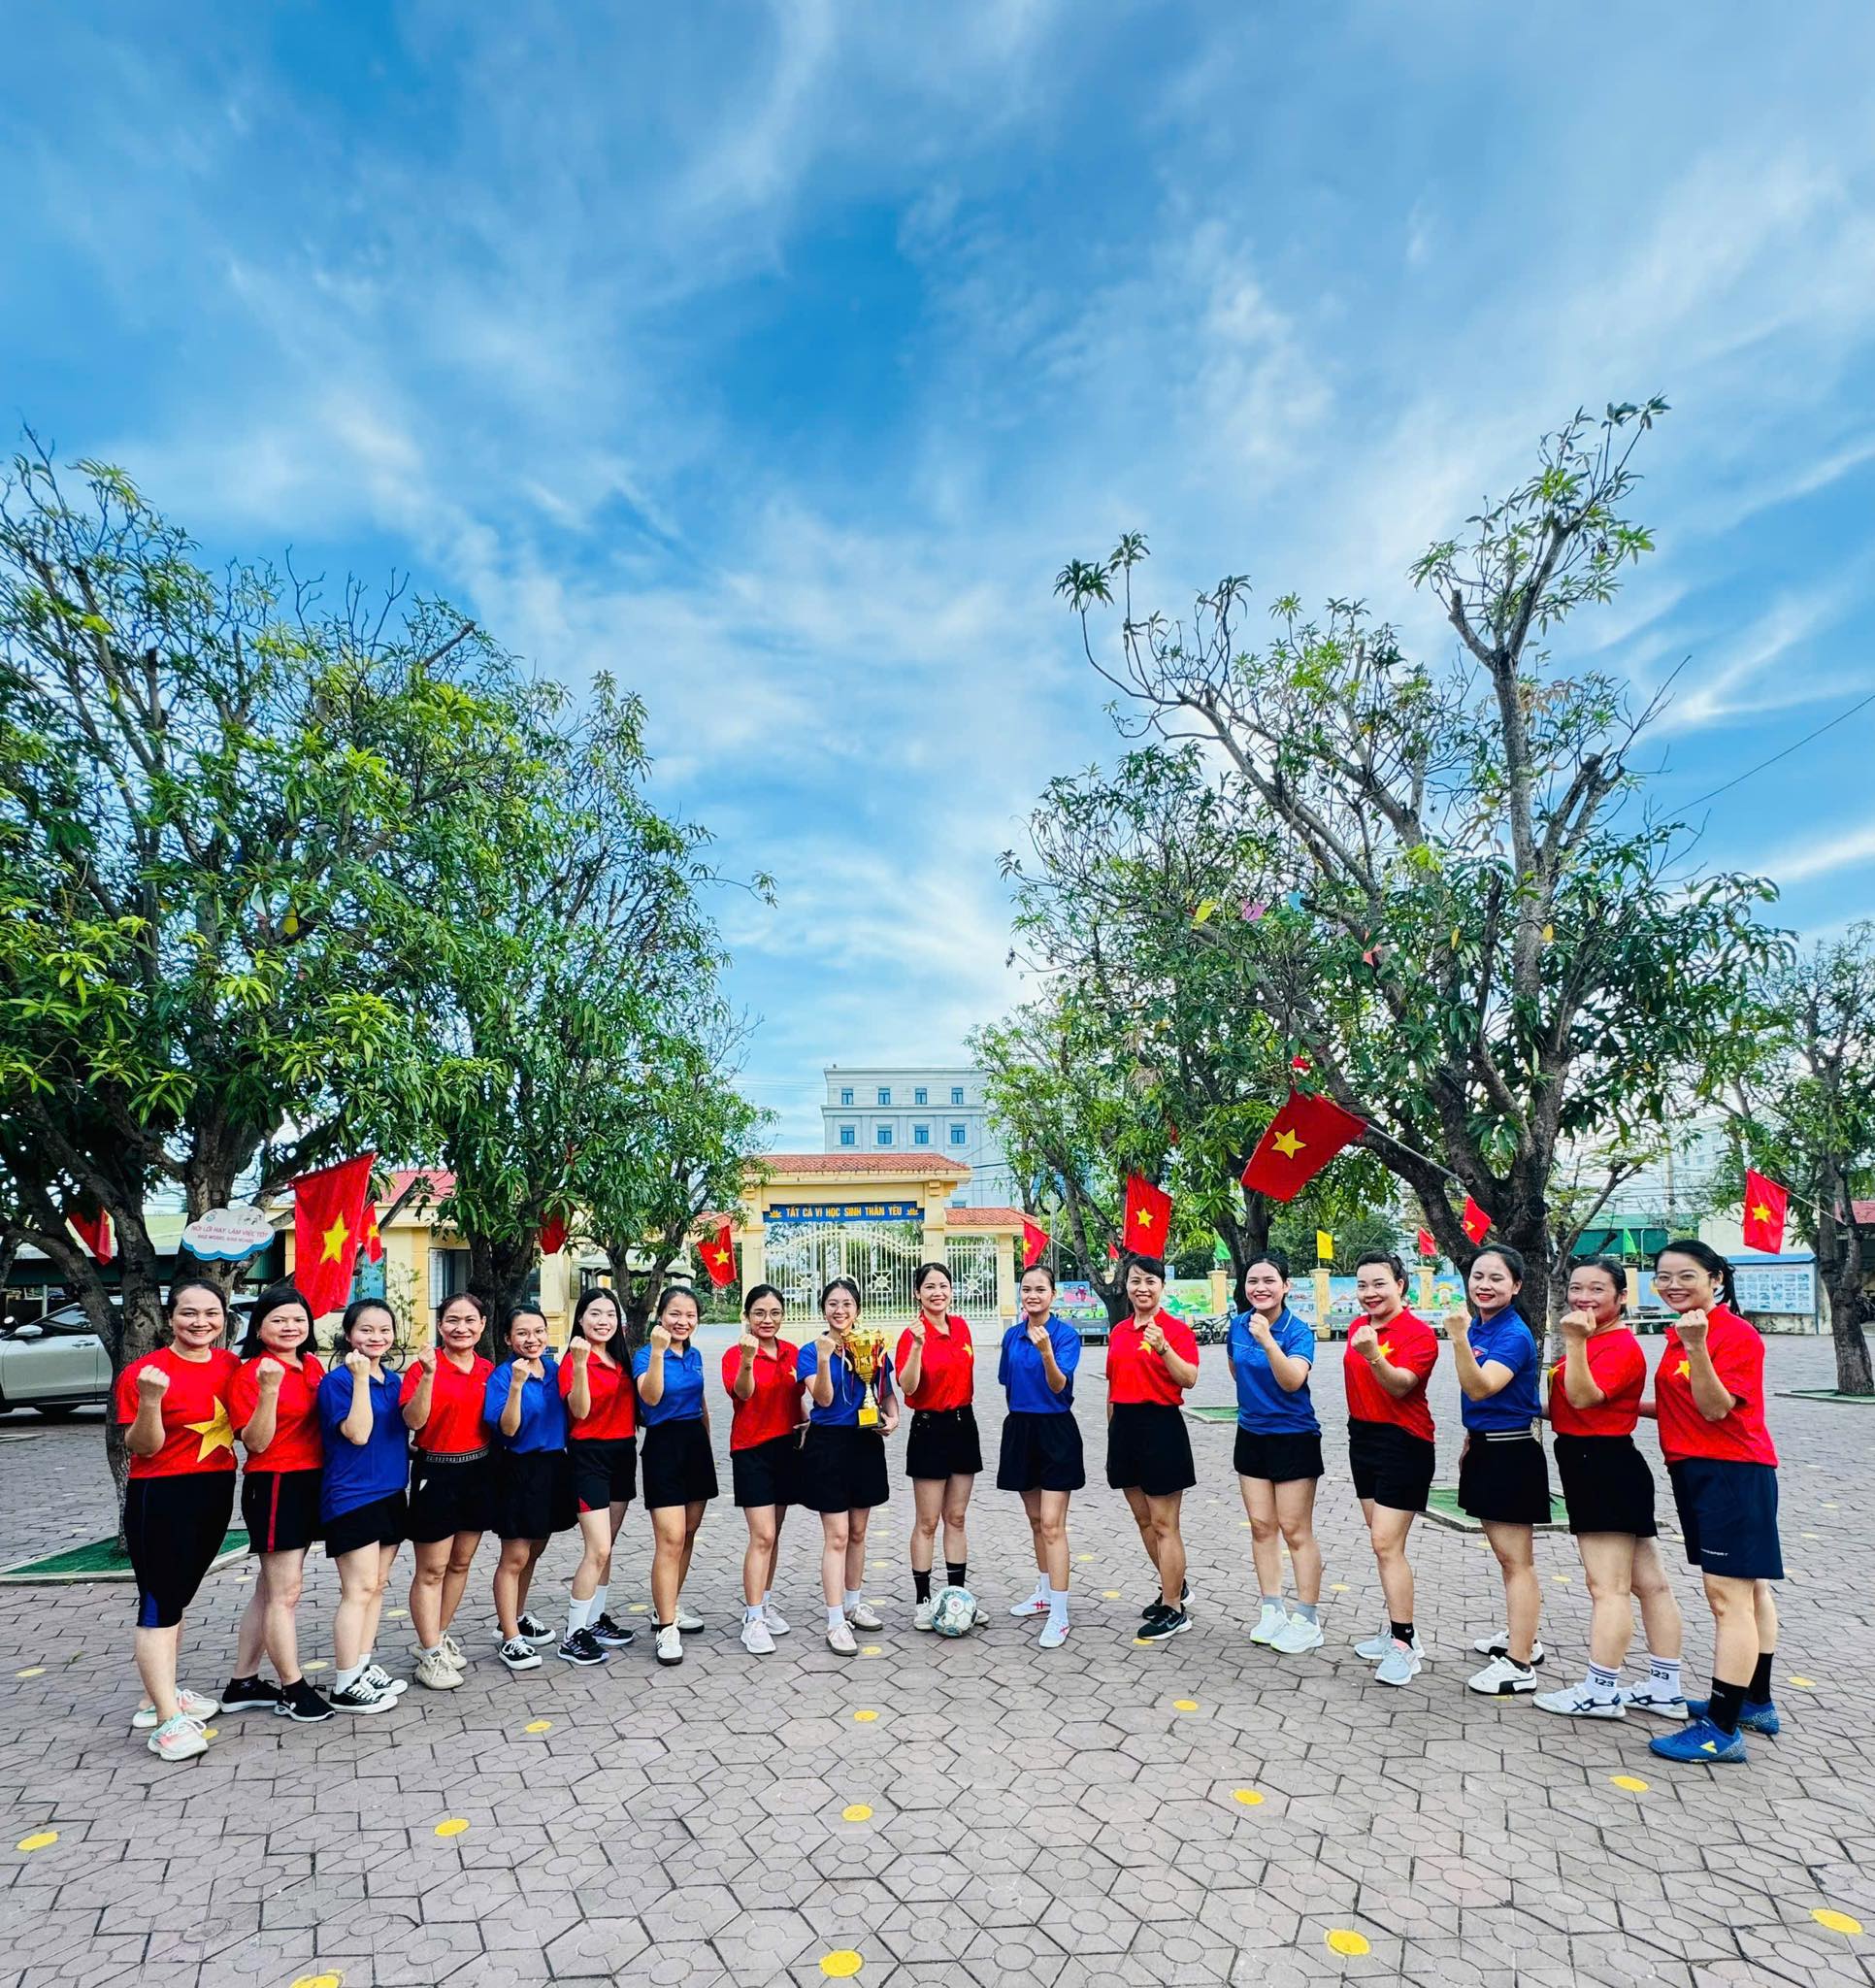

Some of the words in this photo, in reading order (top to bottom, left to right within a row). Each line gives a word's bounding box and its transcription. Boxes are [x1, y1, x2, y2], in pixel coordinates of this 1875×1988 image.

[825, 1207, 840, 1218] HỌC
[843, 1207, 862, 1217] SINH
[865, 1205, 885, 1216] THÂN
[888, 1204, 903, 1216] YÊU
[1650, 1669, 1669, 1680] 123
[1595, 1677, 1615, 1687] 123
